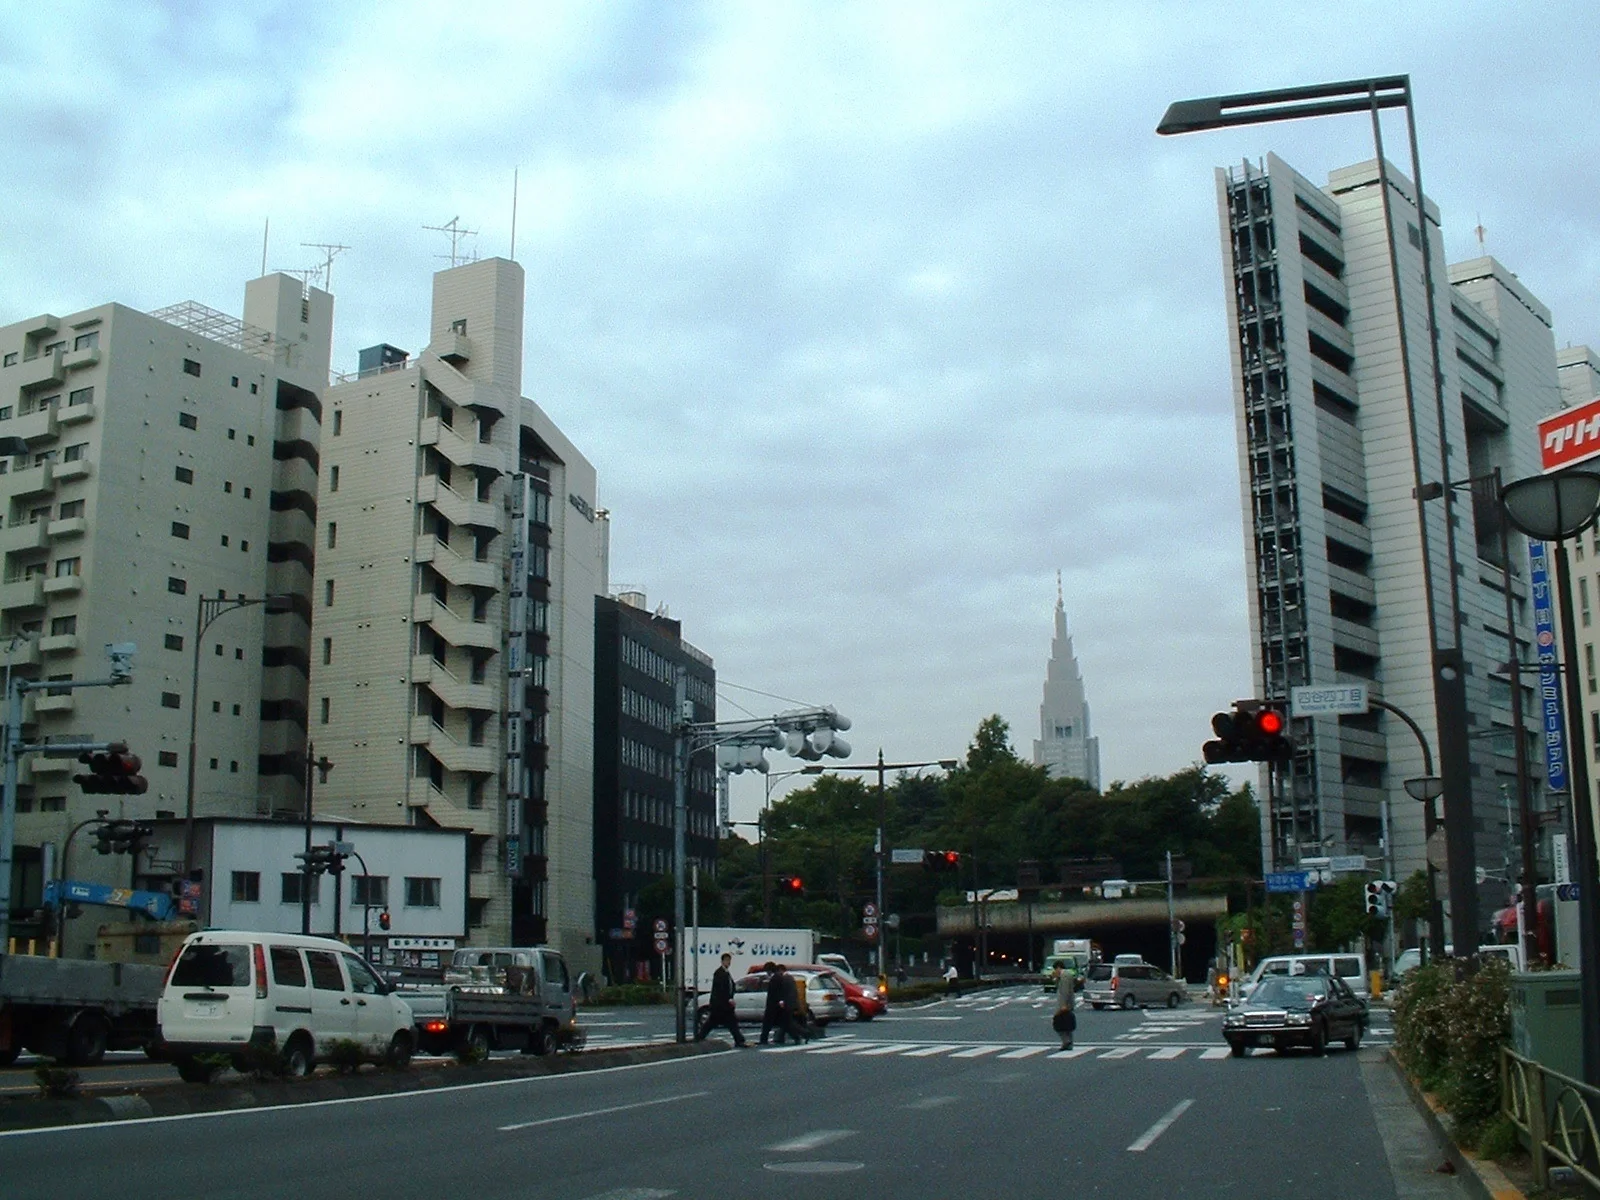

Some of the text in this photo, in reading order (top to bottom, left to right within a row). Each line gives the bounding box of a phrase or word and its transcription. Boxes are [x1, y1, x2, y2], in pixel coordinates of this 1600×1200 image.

[1298, 689, 1362, 703] 四谷四丁目
